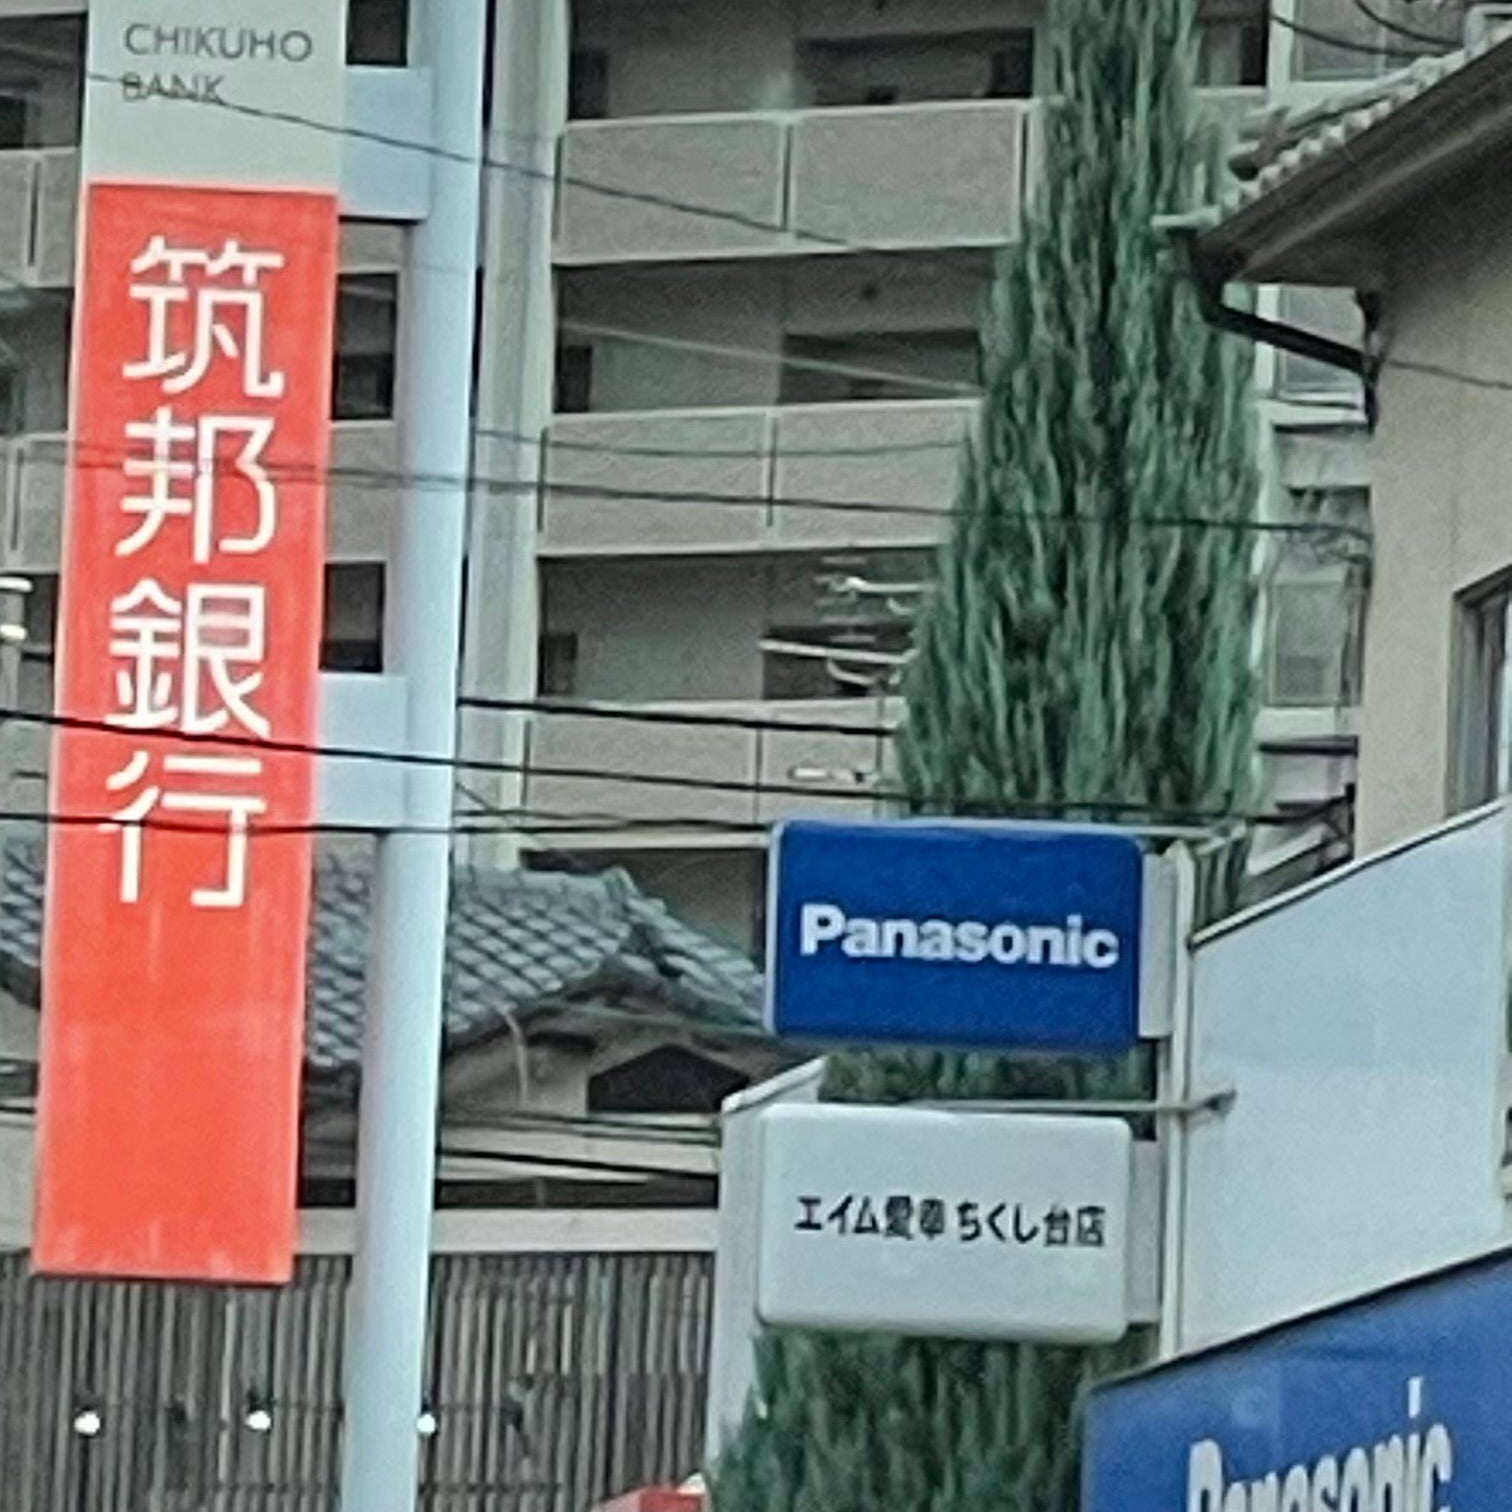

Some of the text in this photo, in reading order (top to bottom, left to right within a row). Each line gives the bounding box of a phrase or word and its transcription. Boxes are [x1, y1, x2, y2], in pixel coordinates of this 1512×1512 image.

[123, 22, 313, 63] CHIKUHO
[121, 72, 226, 106] BANK
[97, 235, 285, 907] 筑邦銀行
[800, 903, 1120, 968] Panasonic
